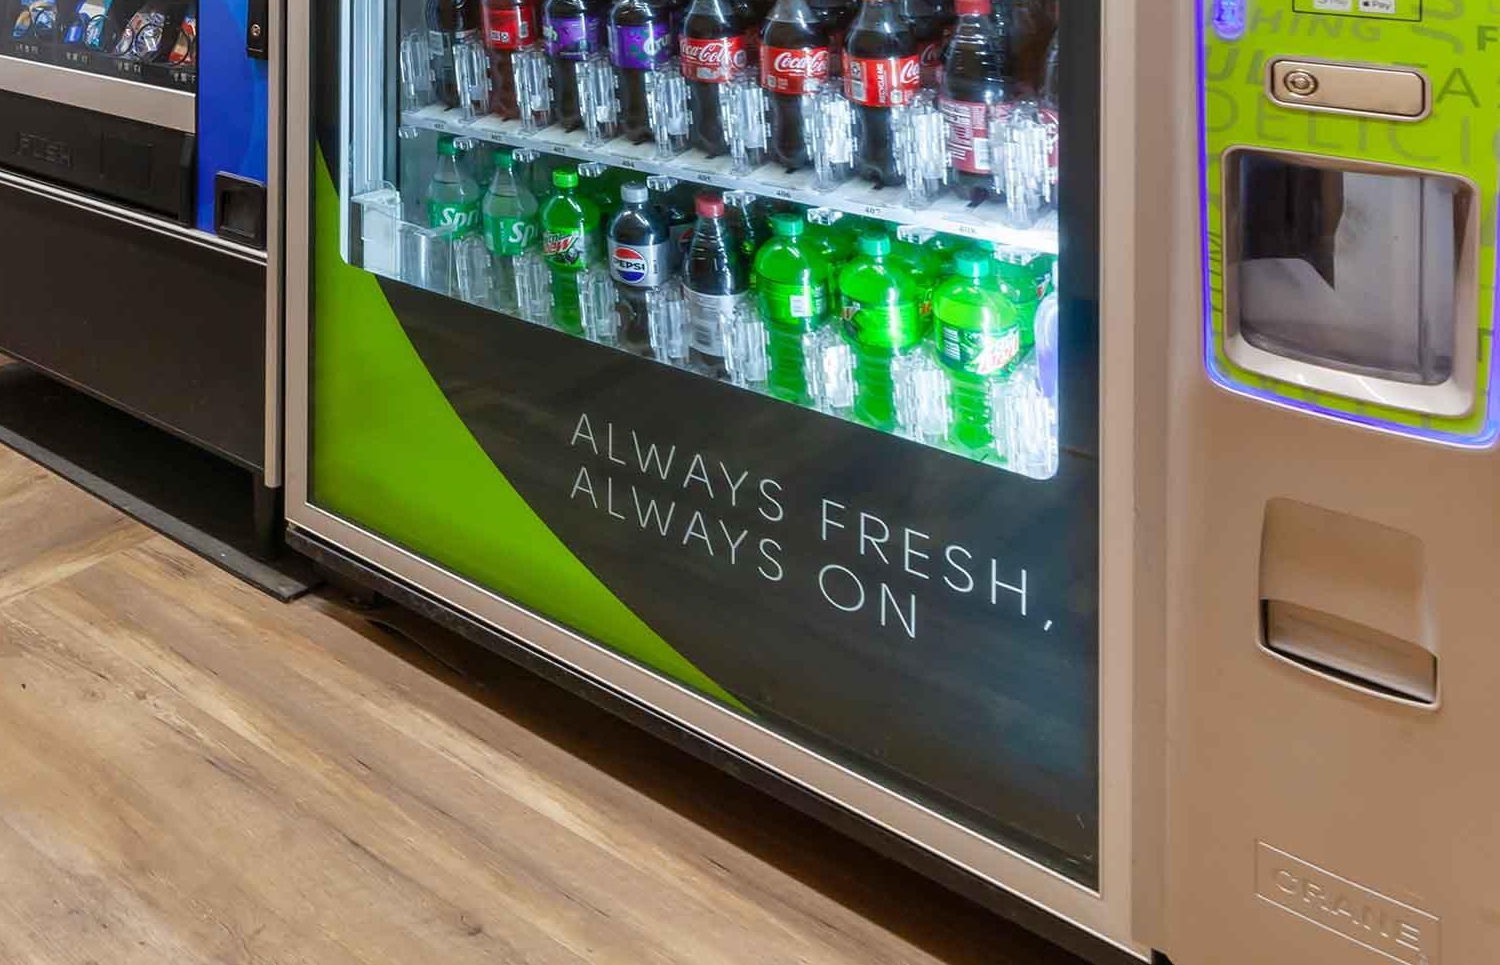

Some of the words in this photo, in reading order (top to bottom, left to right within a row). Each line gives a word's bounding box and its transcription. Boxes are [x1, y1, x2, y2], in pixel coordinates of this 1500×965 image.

[570, 466, 784, 582] ALWAYS
[818, 564, 916, 639] ON
[571, 412, 784, 522] ALWAYS
[822, 498, 1053, 632] FRESH,
